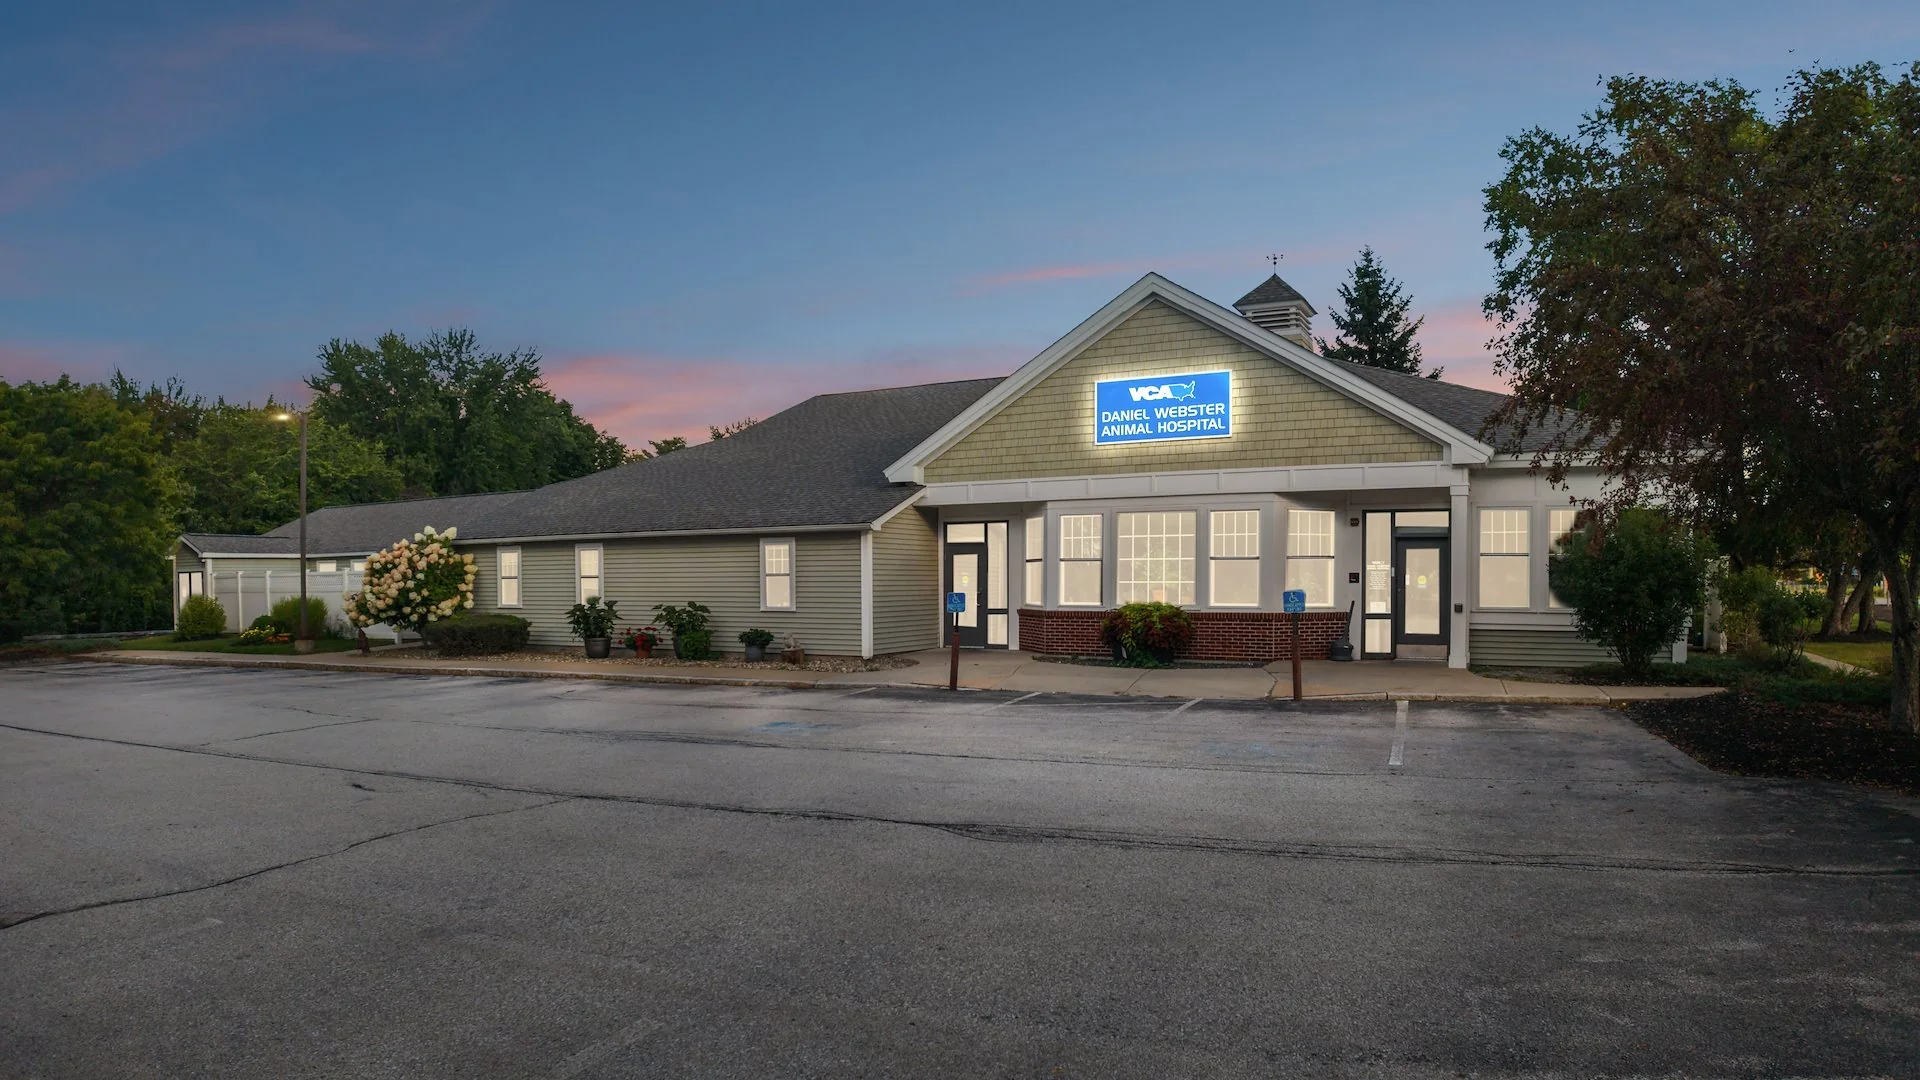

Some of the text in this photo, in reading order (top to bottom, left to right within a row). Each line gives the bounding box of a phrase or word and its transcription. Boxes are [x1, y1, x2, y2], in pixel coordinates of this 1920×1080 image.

[1129, 384, 1174, 401] VCA
[1102, 403, 1225, 423] DANIEL WEBSTER
[1101, 418, 1225, 437] ANIMAL HOSPITAL
